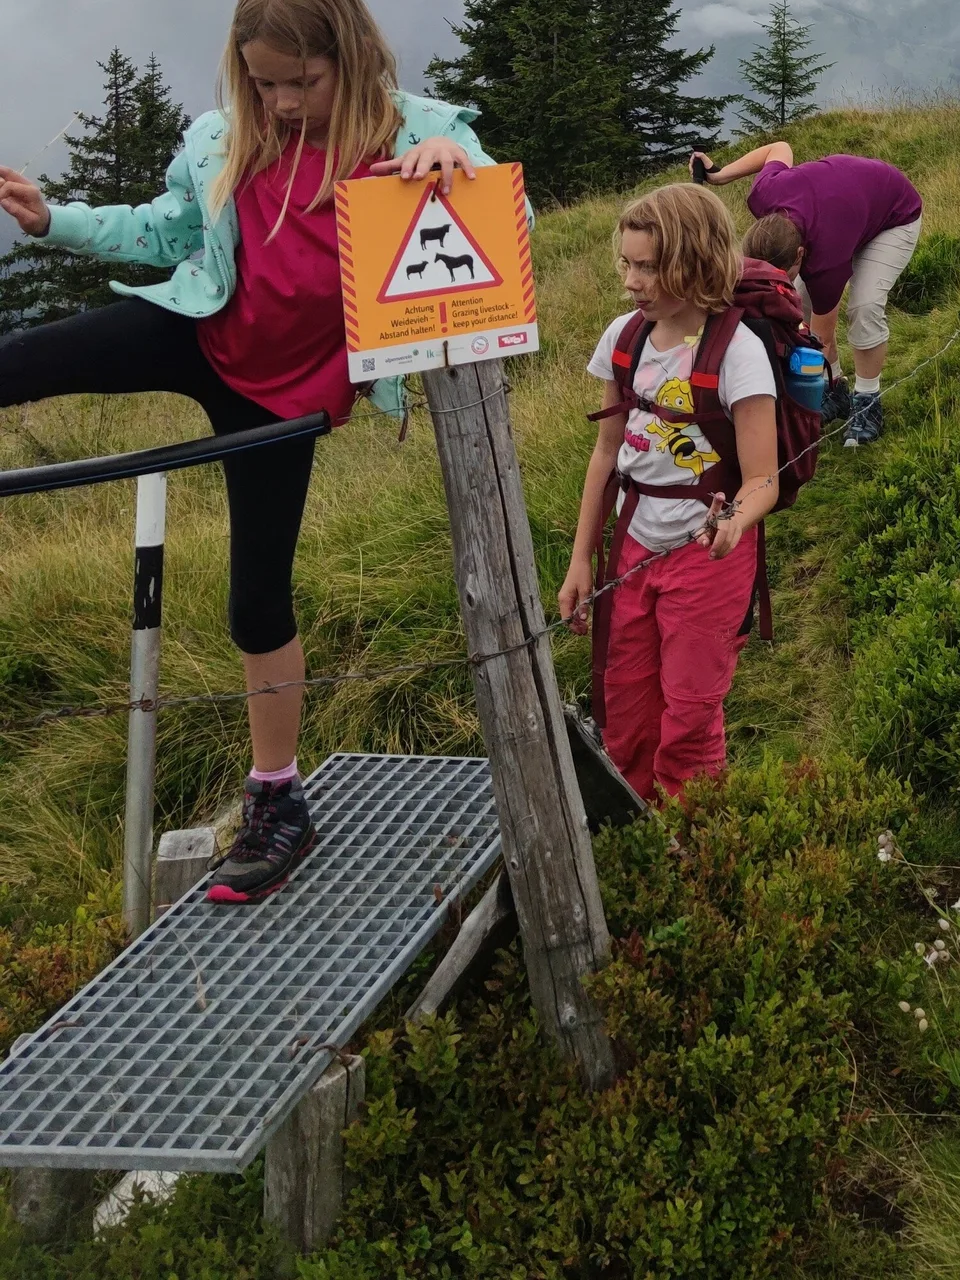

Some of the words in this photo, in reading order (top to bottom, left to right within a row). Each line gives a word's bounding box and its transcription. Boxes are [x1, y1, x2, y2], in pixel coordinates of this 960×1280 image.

[451, 297, 483, 308] Attention
[405, 305, 434, 315] Achtung
[452, 308, 479, 318] Grazing
[480, 302, 509, 313] livestock
[390, 315, 429, 327] Weidevieh
[452, 320, 470, 328] keep
[471, 317, 486, 327] your
[487, 311, 518, 323] distance!
[379, 328, 409, 340] Abstand
[410, 324, 436, 336] halten!
